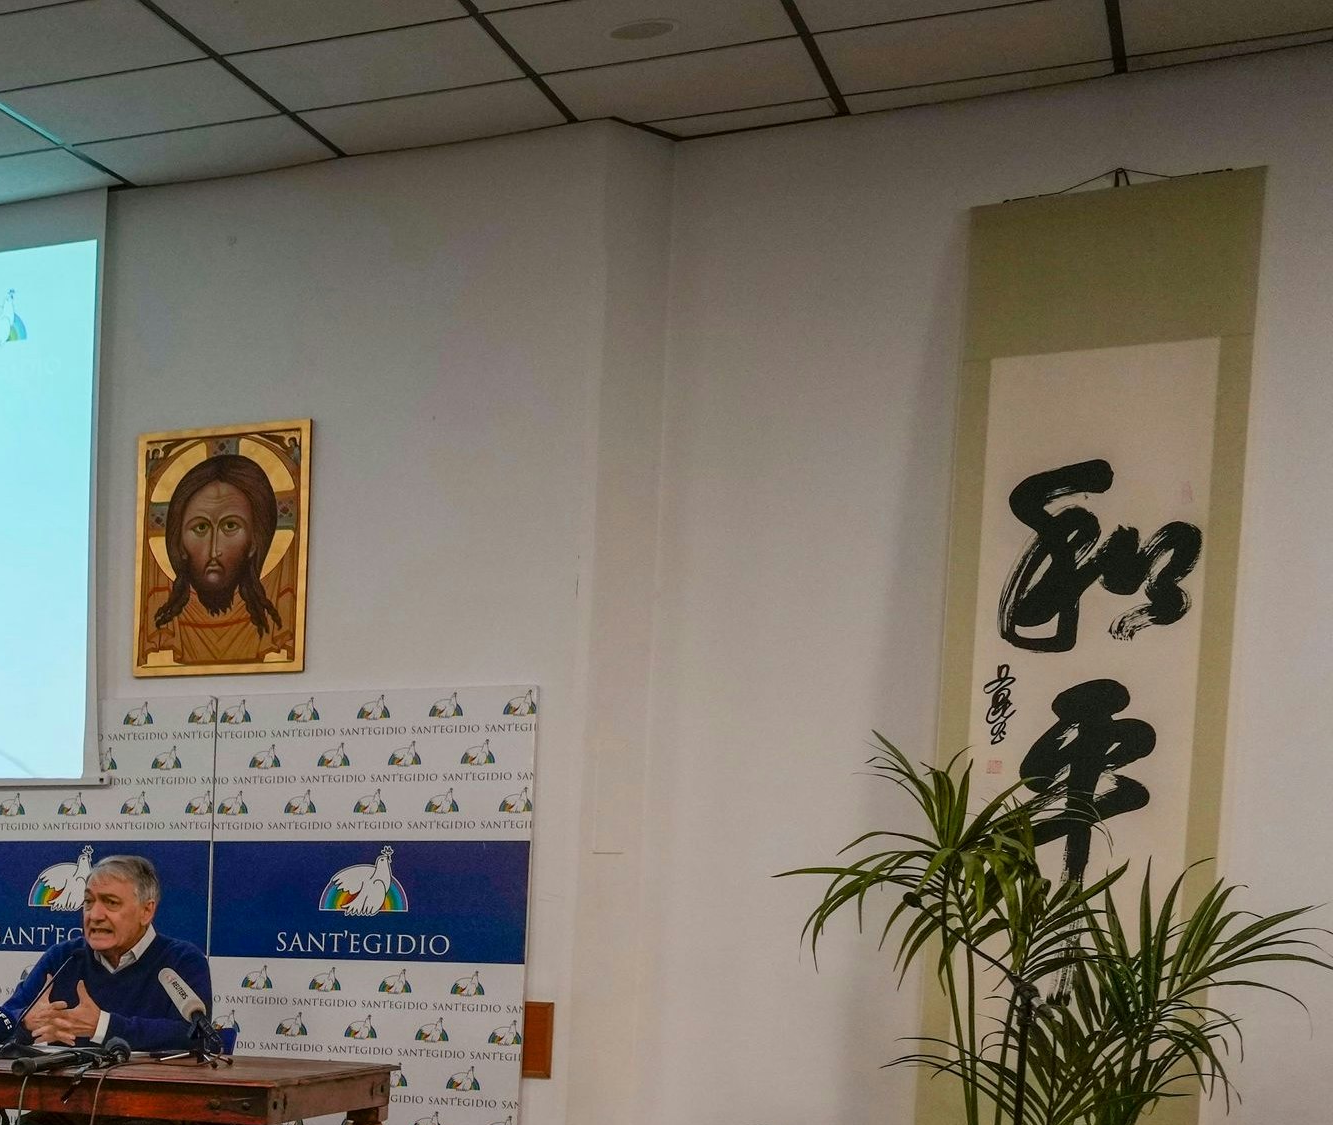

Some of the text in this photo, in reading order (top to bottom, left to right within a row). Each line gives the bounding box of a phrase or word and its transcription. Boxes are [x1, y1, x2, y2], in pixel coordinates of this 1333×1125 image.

[108, 732, 168, 741] SANT'EGIDIO
[271, 727, 335, 738] SANT'EGIDIO
[340, 726, 406, 736] SANT'EGIDIO
[411, 724, 480, 734] SANT'EGIDIO
[135, 776, 196, 785] SANT'EGIDIO
[233, 774, 296, 784] SANT'EGIDIO
[300, 774, 366, 784] SANT'EGIDIO
[370, 773, 438, 783] SANT'EGIDIO
[442, 772, 512, 782] SANT'EGIDIO
[42, 821, 101, 831] SANT'EGIDIO
[105, 821, 165, 830] SANT'EGIDIO
[267, 820, 332, 830] SANT'EGIDIO
[336, 820, 402, 830] SANT'EGIDIO
[407, 819, 475, 830] SANT'EGIDIO
[276, 930, 450, 956] SANT'EGIDIO
[172, 981, 188, 1000] REUTERS
[226, 995, 288, 1005] SANT'EGIDIO
[292, 997, 357, 1008] SANT'EGIDIO
[361, 1000, 428, 1010] SANT'EGIDIO
[432, 1001, 501, 1013] SANT'EGIDIO
[260, 1041, 323, 1052] SANT'EGIDIO
[327, 1044, 392, 1056] SANT'EGIDIO
[397, 1047, 465, 1060] SANT'EGIDIO
[428, 1096, 496, 1109] SANT'EGIDIO
